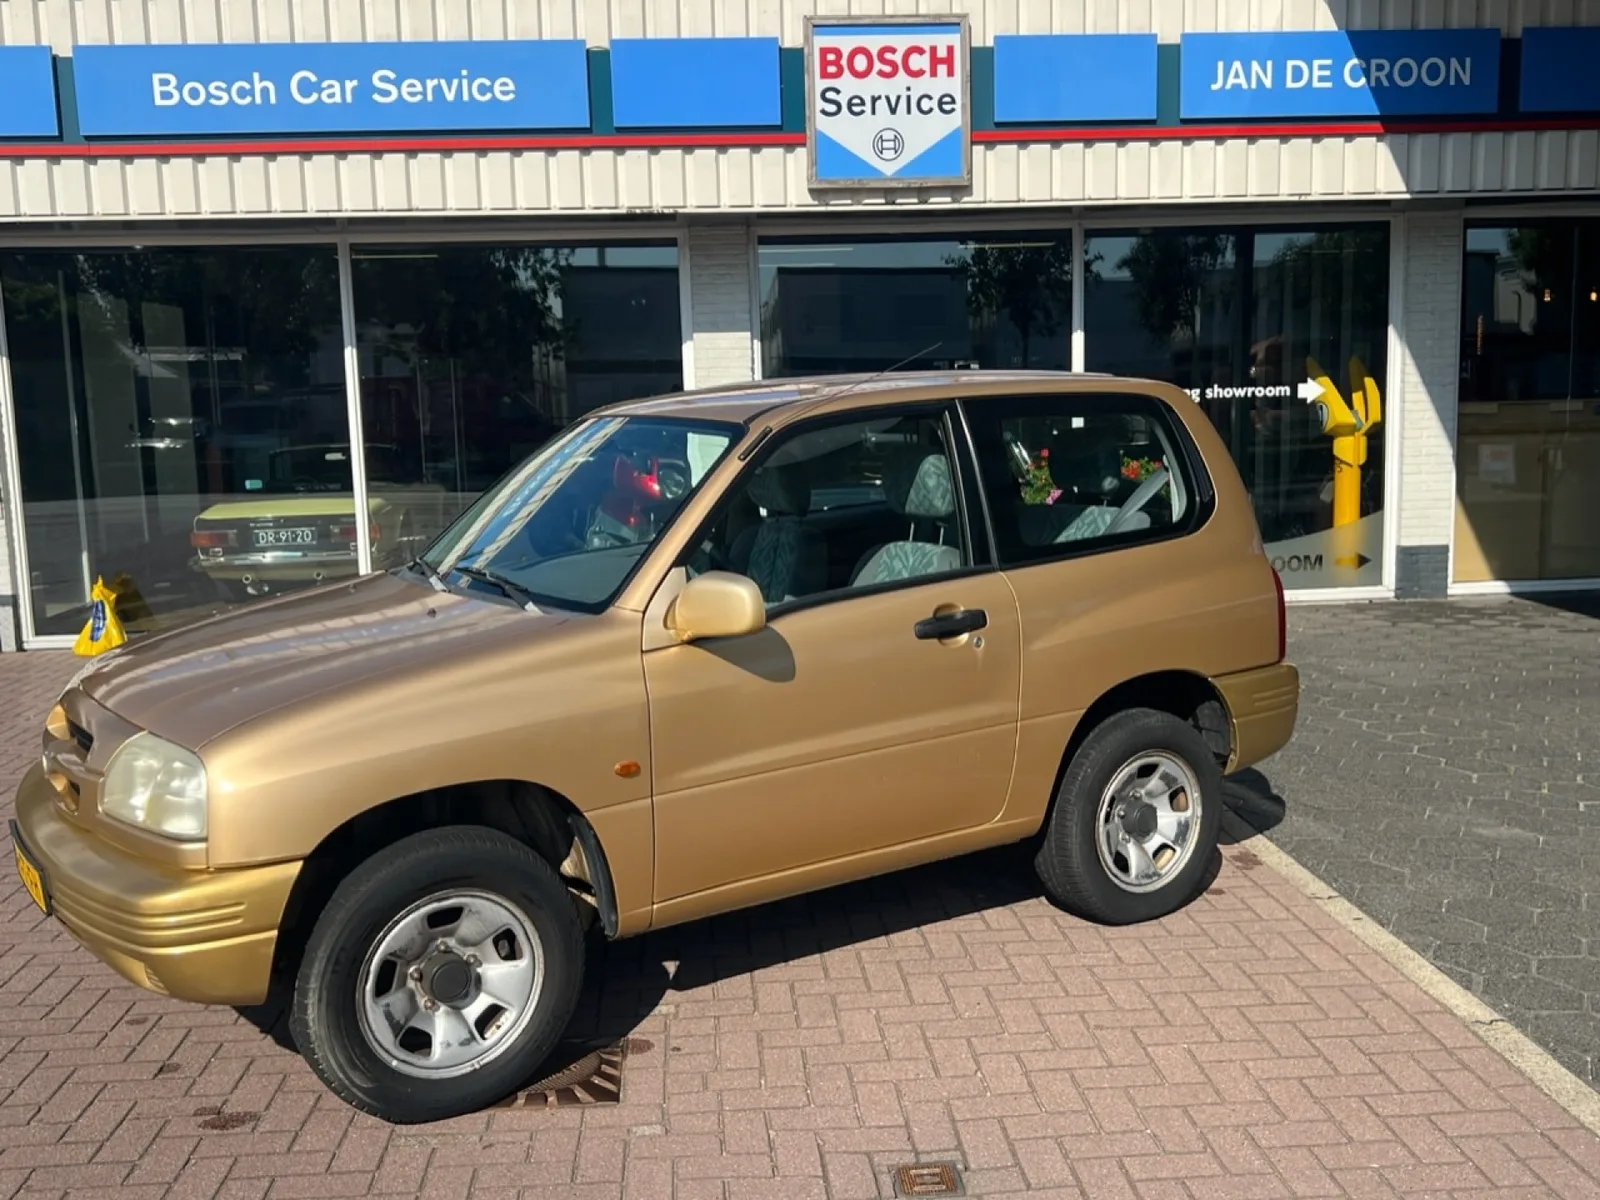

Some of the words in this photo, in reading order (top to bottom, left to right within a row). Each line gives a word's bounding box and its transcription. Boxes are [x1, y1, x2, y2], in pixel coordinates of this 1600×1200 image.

[819, 45, 955, 80] BOSCH
[1210, 60, 1273, 90] JAN
[1285, 59, 1333, 89] DE
[1343, 56, 1472, 88] CROON
[152, 72, 276, 106] Bosch
[289, 70, 358, 105] Car
[371, 69, 516, 104] Service
[819, 86, 957, 117] Service
[1205, 384, 1291, 399] showroom
